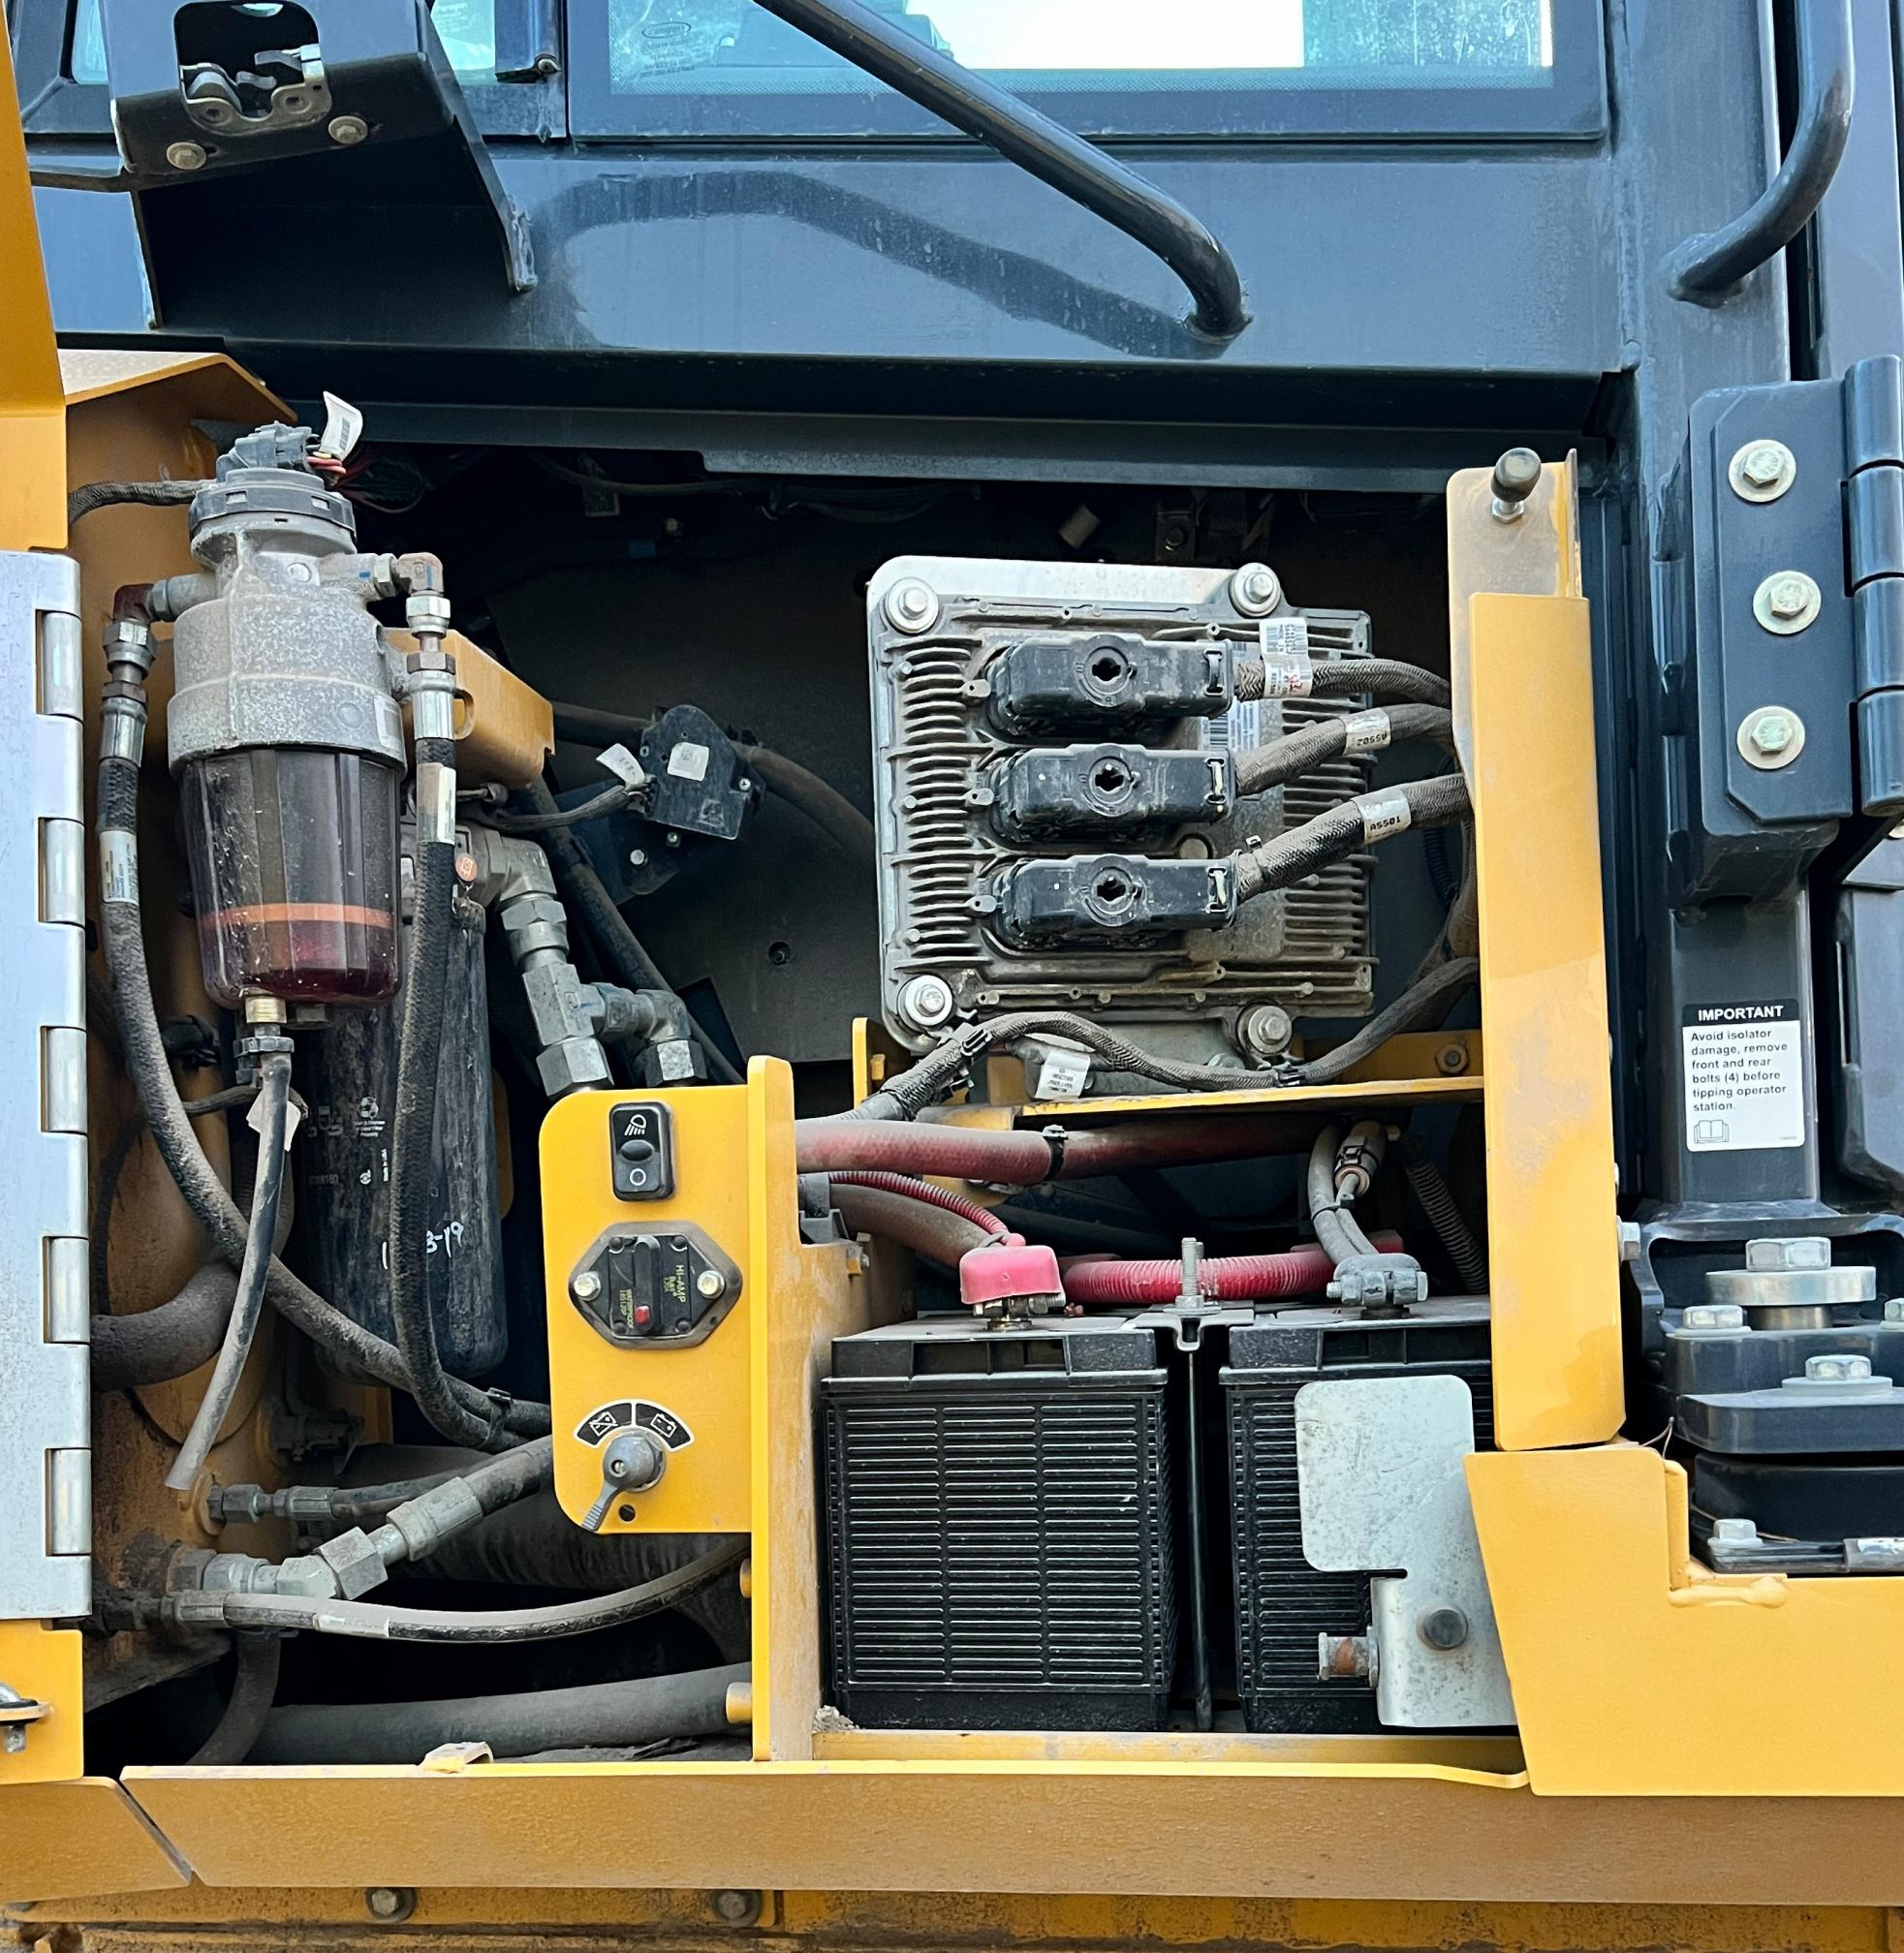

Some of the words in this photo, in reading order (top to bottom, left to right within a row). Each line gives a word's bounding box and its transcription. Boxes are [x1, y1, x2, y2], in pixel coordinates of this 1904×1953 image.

[1698, 1005, 1784, 1021] IMPORTANT
[1691, 1031, 1724, 1041] Avoid
[1727, 1030, 1772, 1039] isolator
[1691, 1046, 1741, 1056] damage,
[1744, 1043, 1788, 1053] remove
[1692, 1060, 1719, 1070] front
[1723, 1058, 1744, 1068] and
[1692, 1074, 1721, 1083] bolts
[1725, 1072, 1739, 1084] (4)
[1743, 1071, 1781, 1081] before
[1693, 1088, 1732, 1099] tipping
[1736, 1085, 1787, 1097] operator
[1693, 1101, 1736, 1111] station.
[675, 1264, 687, 1303] HI-AMP
